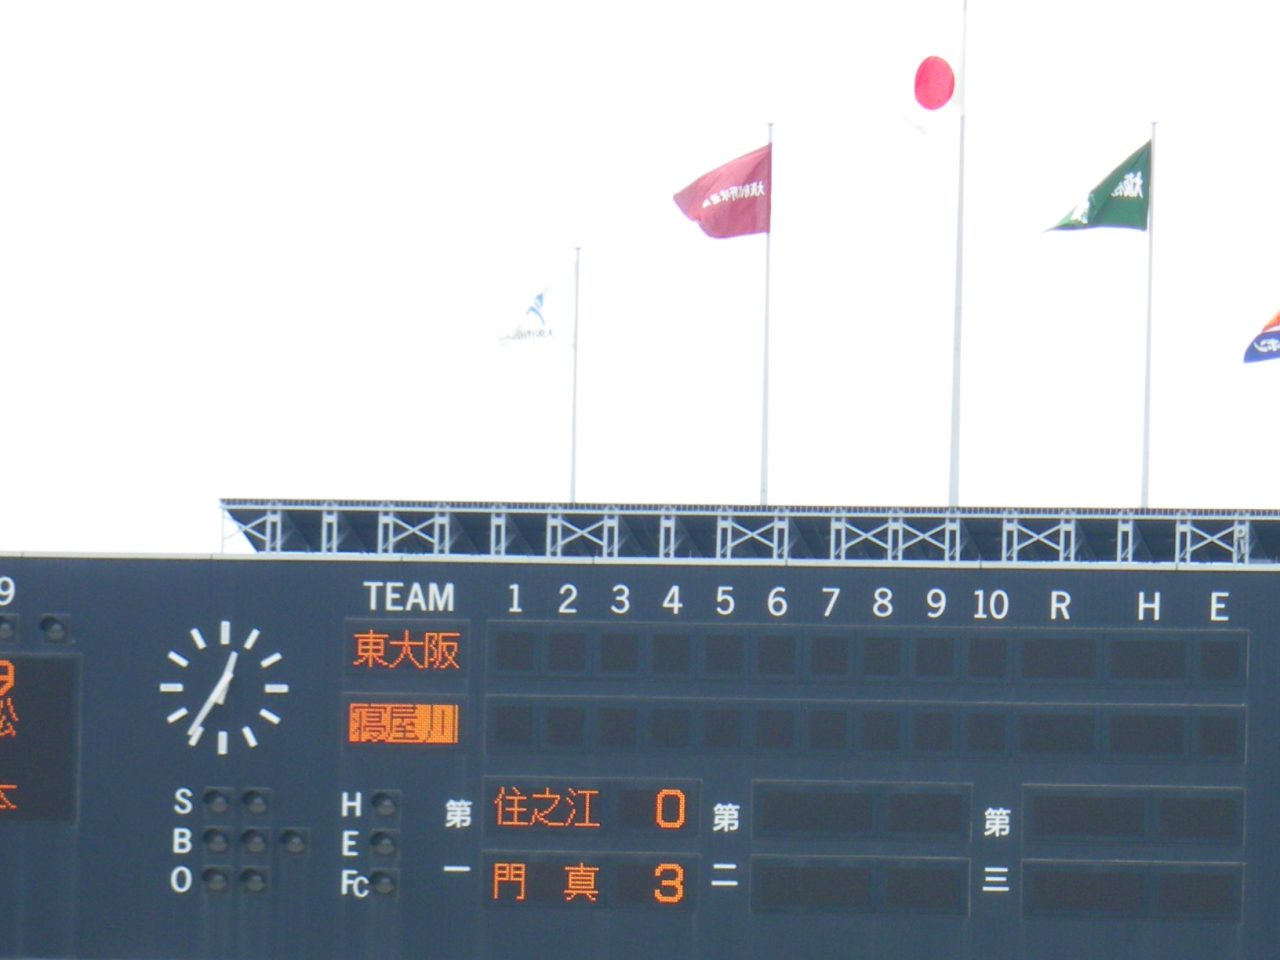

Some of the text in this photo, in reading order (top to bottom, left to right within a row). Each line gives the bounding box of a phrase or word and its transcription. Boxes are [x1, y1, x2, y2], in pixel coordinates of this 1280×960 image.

[363, 581, 1230, 621] TEAM 1 2 3 4 5 6 7 8 9 10 R H E
[353, 630, 460, 670] 東大阪
[174, 788, 193, 815] S
[341, 791, 362, 817] H
[494, 787, 686, 829] 住之江 0
[173, 828, 192, 854] B
[342, 830, 359, 857] E
[654, 864, 684, 903] 3
